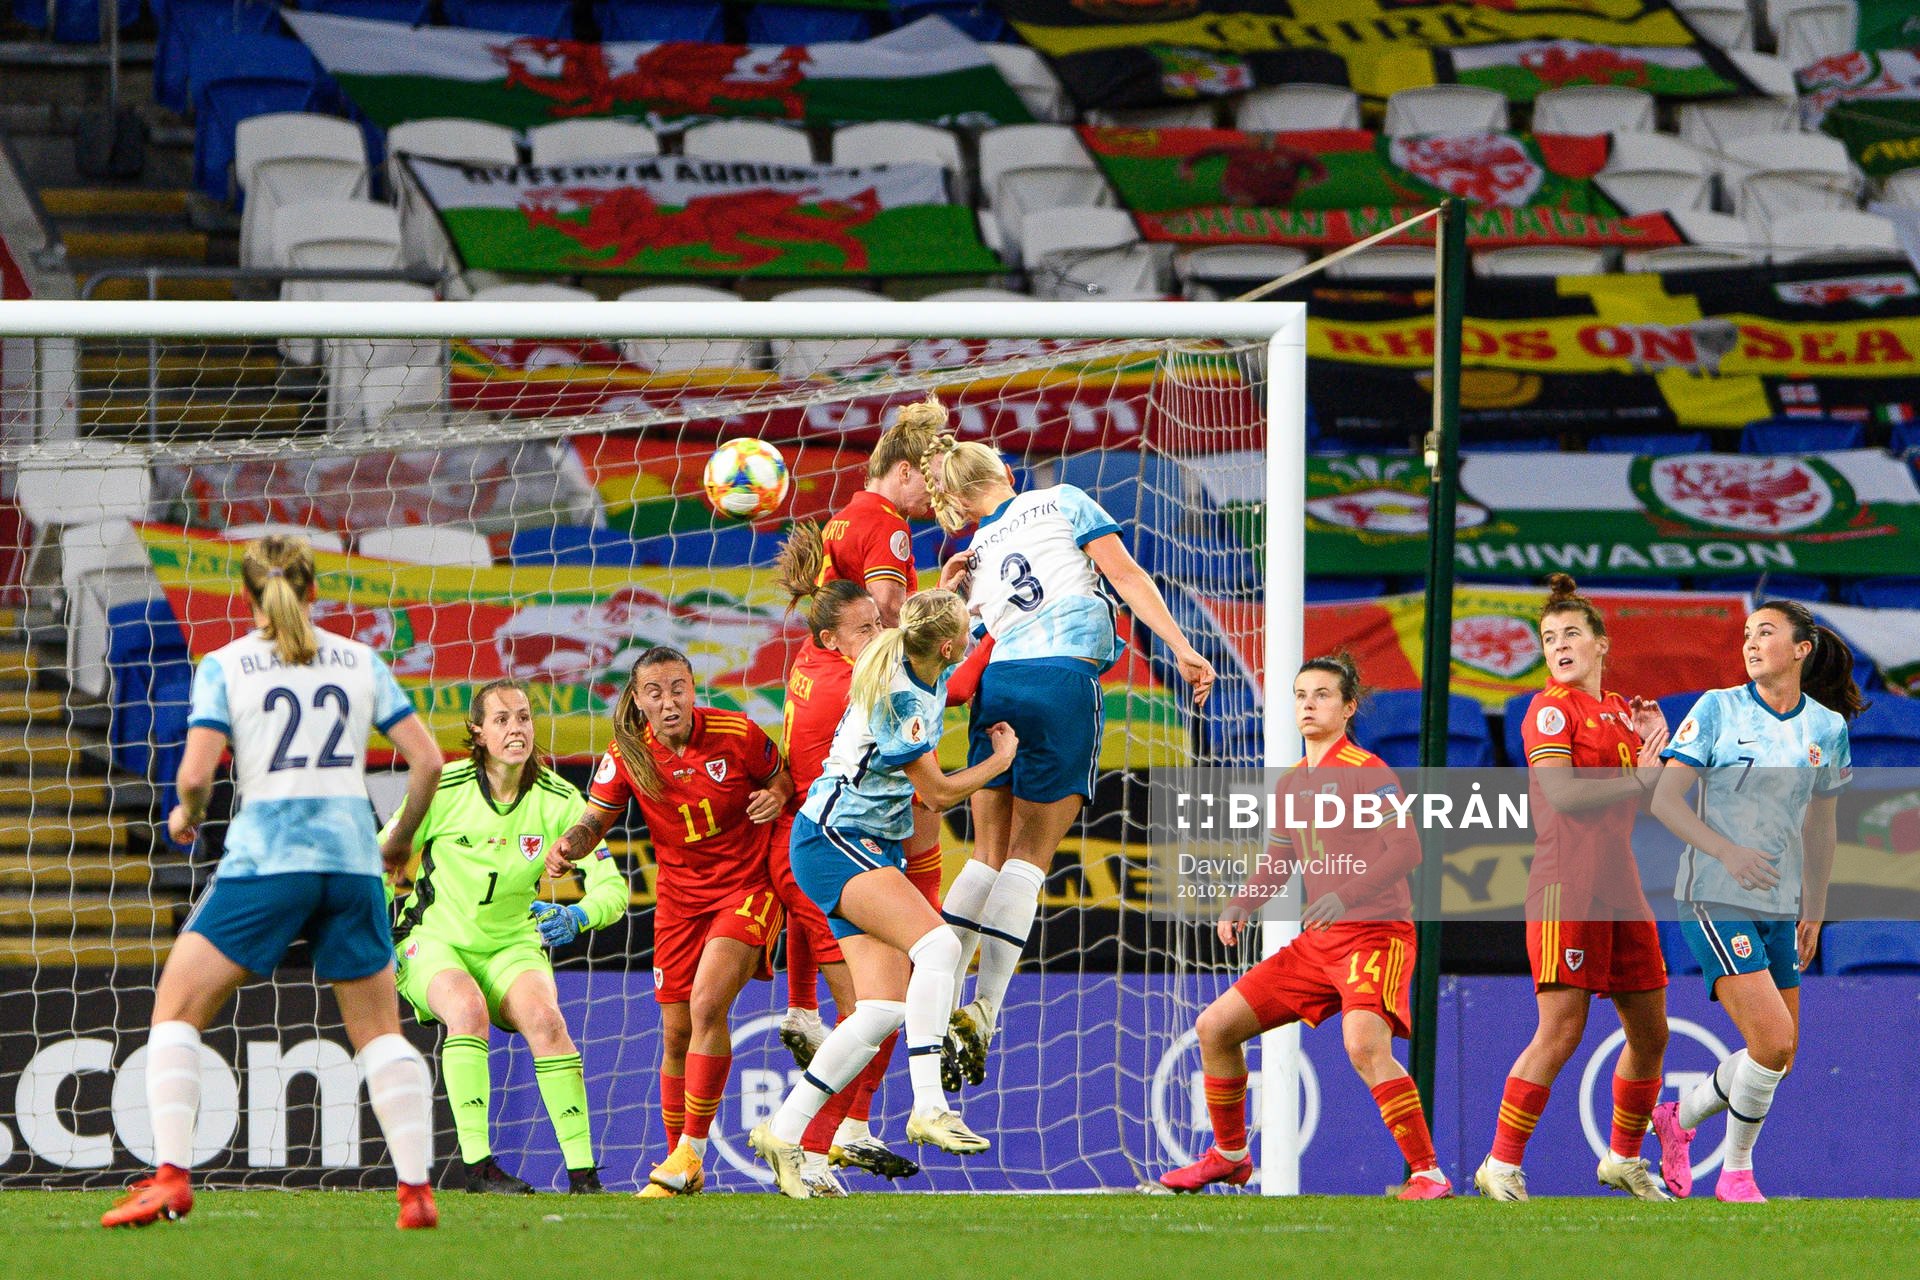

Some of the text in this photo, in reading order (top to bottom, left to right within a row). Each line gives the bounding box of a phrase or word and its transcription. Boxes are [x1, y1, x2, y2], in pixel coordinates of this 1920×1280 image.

[1323, 323, 1913, 366] RHOS ON SEA
[1000, 552, 1045, 613] 3
[264, 683, 354, 773] 22
[1734, 756, 1755, 792] 7
[678, 798, 721, 843] 11
[478, 872, 498, 906] 1
[735, 892, 774, 927] 11
[1346, 951, 1380, 985] 14
[0, 1038, 433, 1168] com
